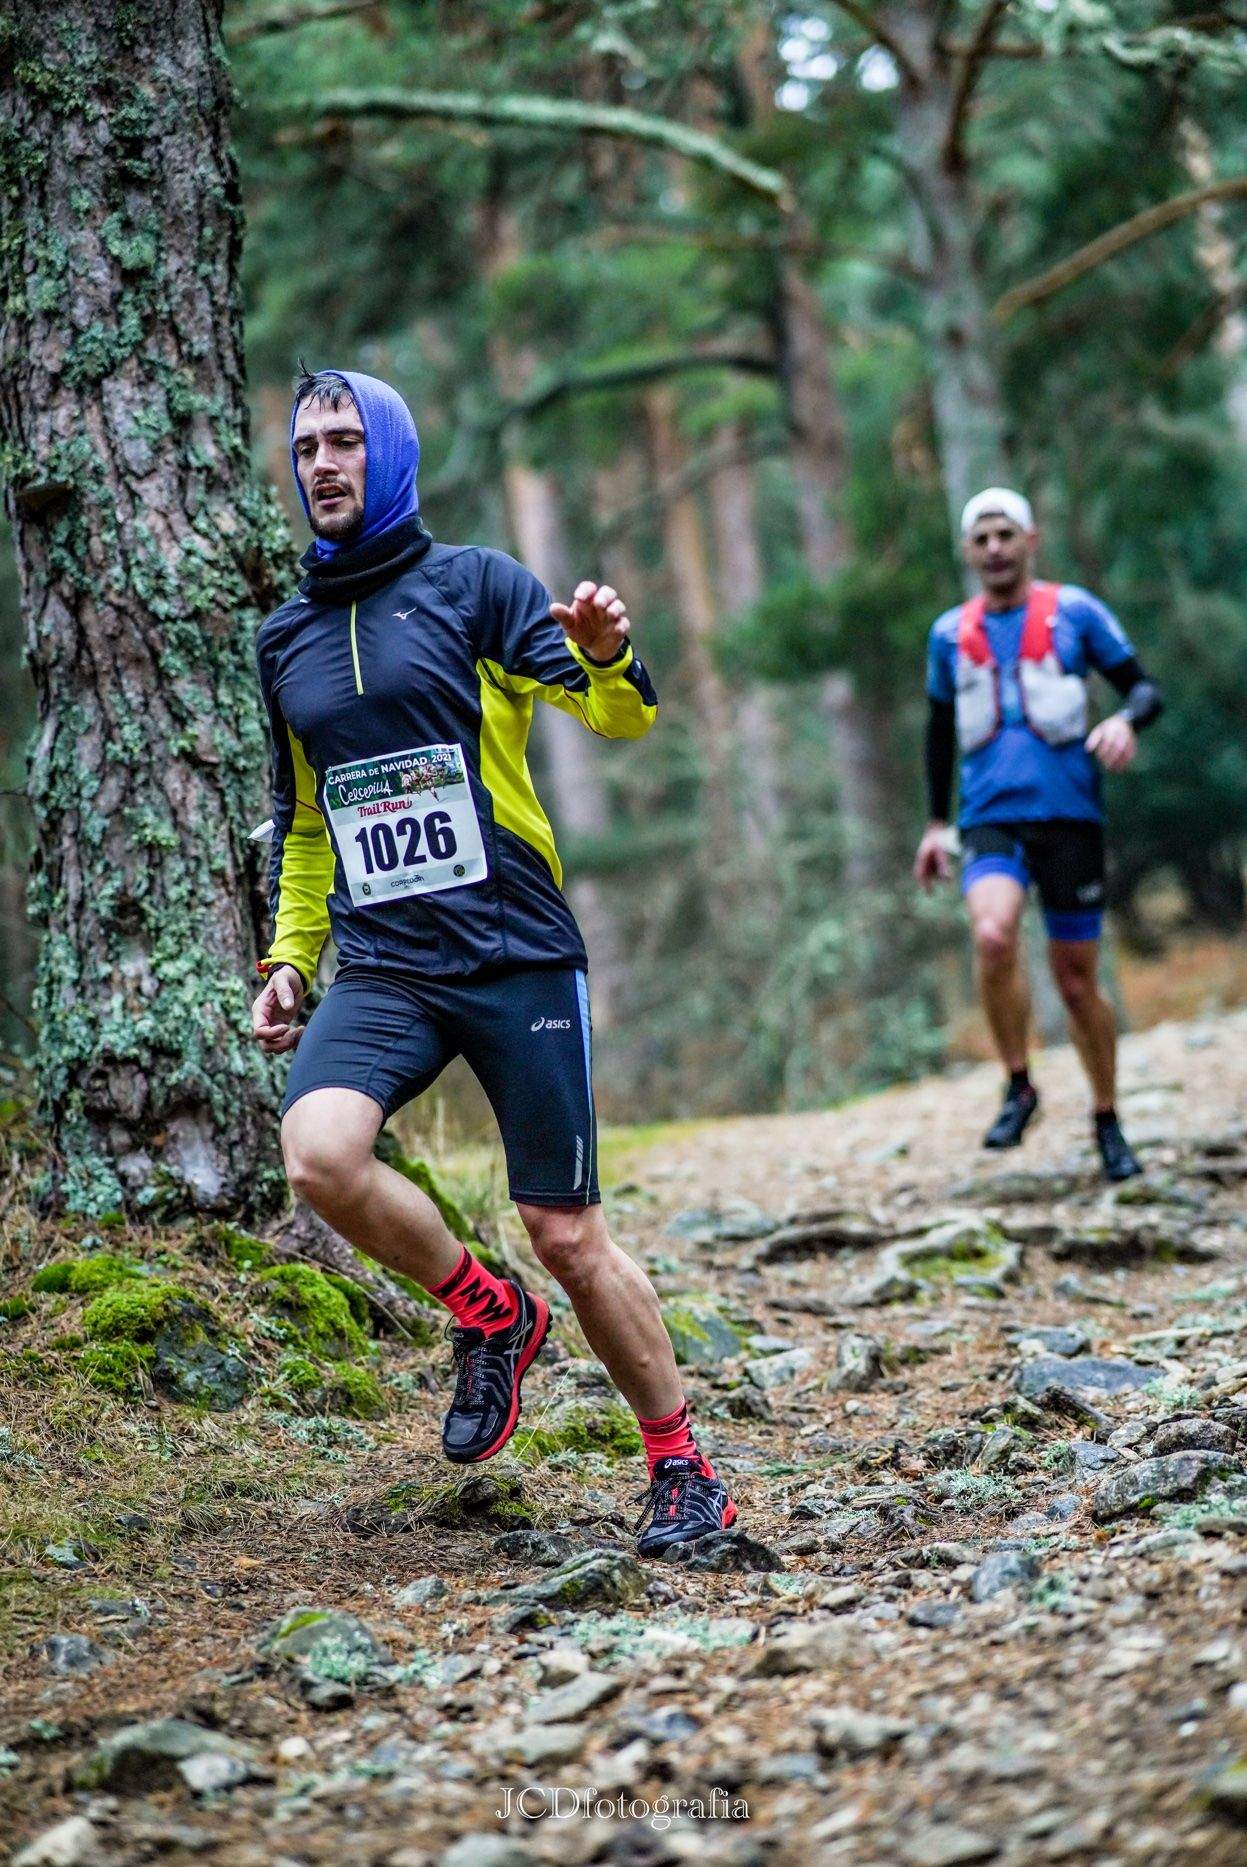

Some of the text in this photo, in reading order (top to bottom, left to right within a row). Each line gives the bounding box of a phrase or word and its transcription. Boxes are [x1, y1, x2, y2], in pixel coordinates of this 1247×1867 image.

[328, 753, 452, 785] CARRERA DE NAVIDAD 2021
[357, 798, 412, 817] Trail Run
[354, 810, 458, 875] 1026
[544, 1018, 571, 1030] asics
[671, 1459, 688, 1467] asics
